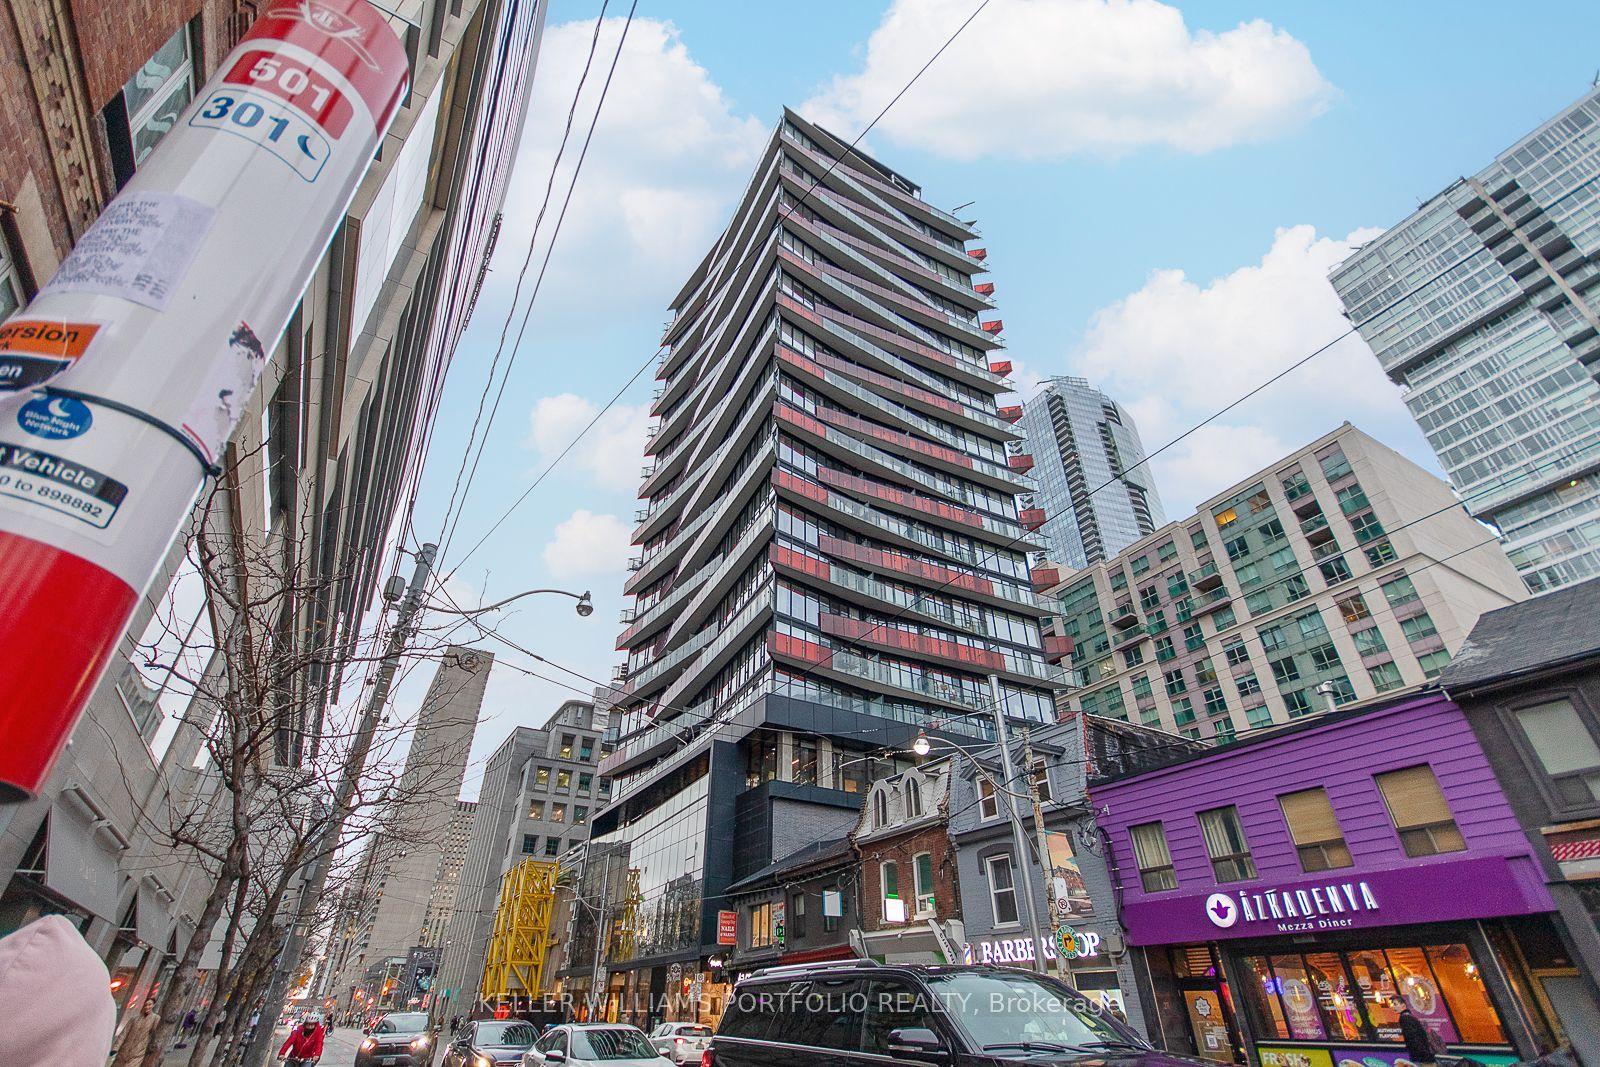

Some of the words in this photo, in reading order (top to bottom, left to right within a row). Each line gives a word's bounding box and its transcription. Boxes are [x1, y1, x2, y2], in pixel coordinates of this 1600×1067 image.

[249, 57, 330, 112] 501
[202, 96, 290, 143] 301
[25, 410, 49, 421] Blue
[50, 415, 80, 432] Night
[25, 419, 69, 437] Network
[13, 449, 96, 489] Vehicle
[15, 479, 33, 492] to
[37, 485, 102, 518] 898882
[1277, 921, 1314, 932] Mezza
[1319, 918, 1353, 929] Diner
[981, 932, 1100, 963] BARBERSOP
